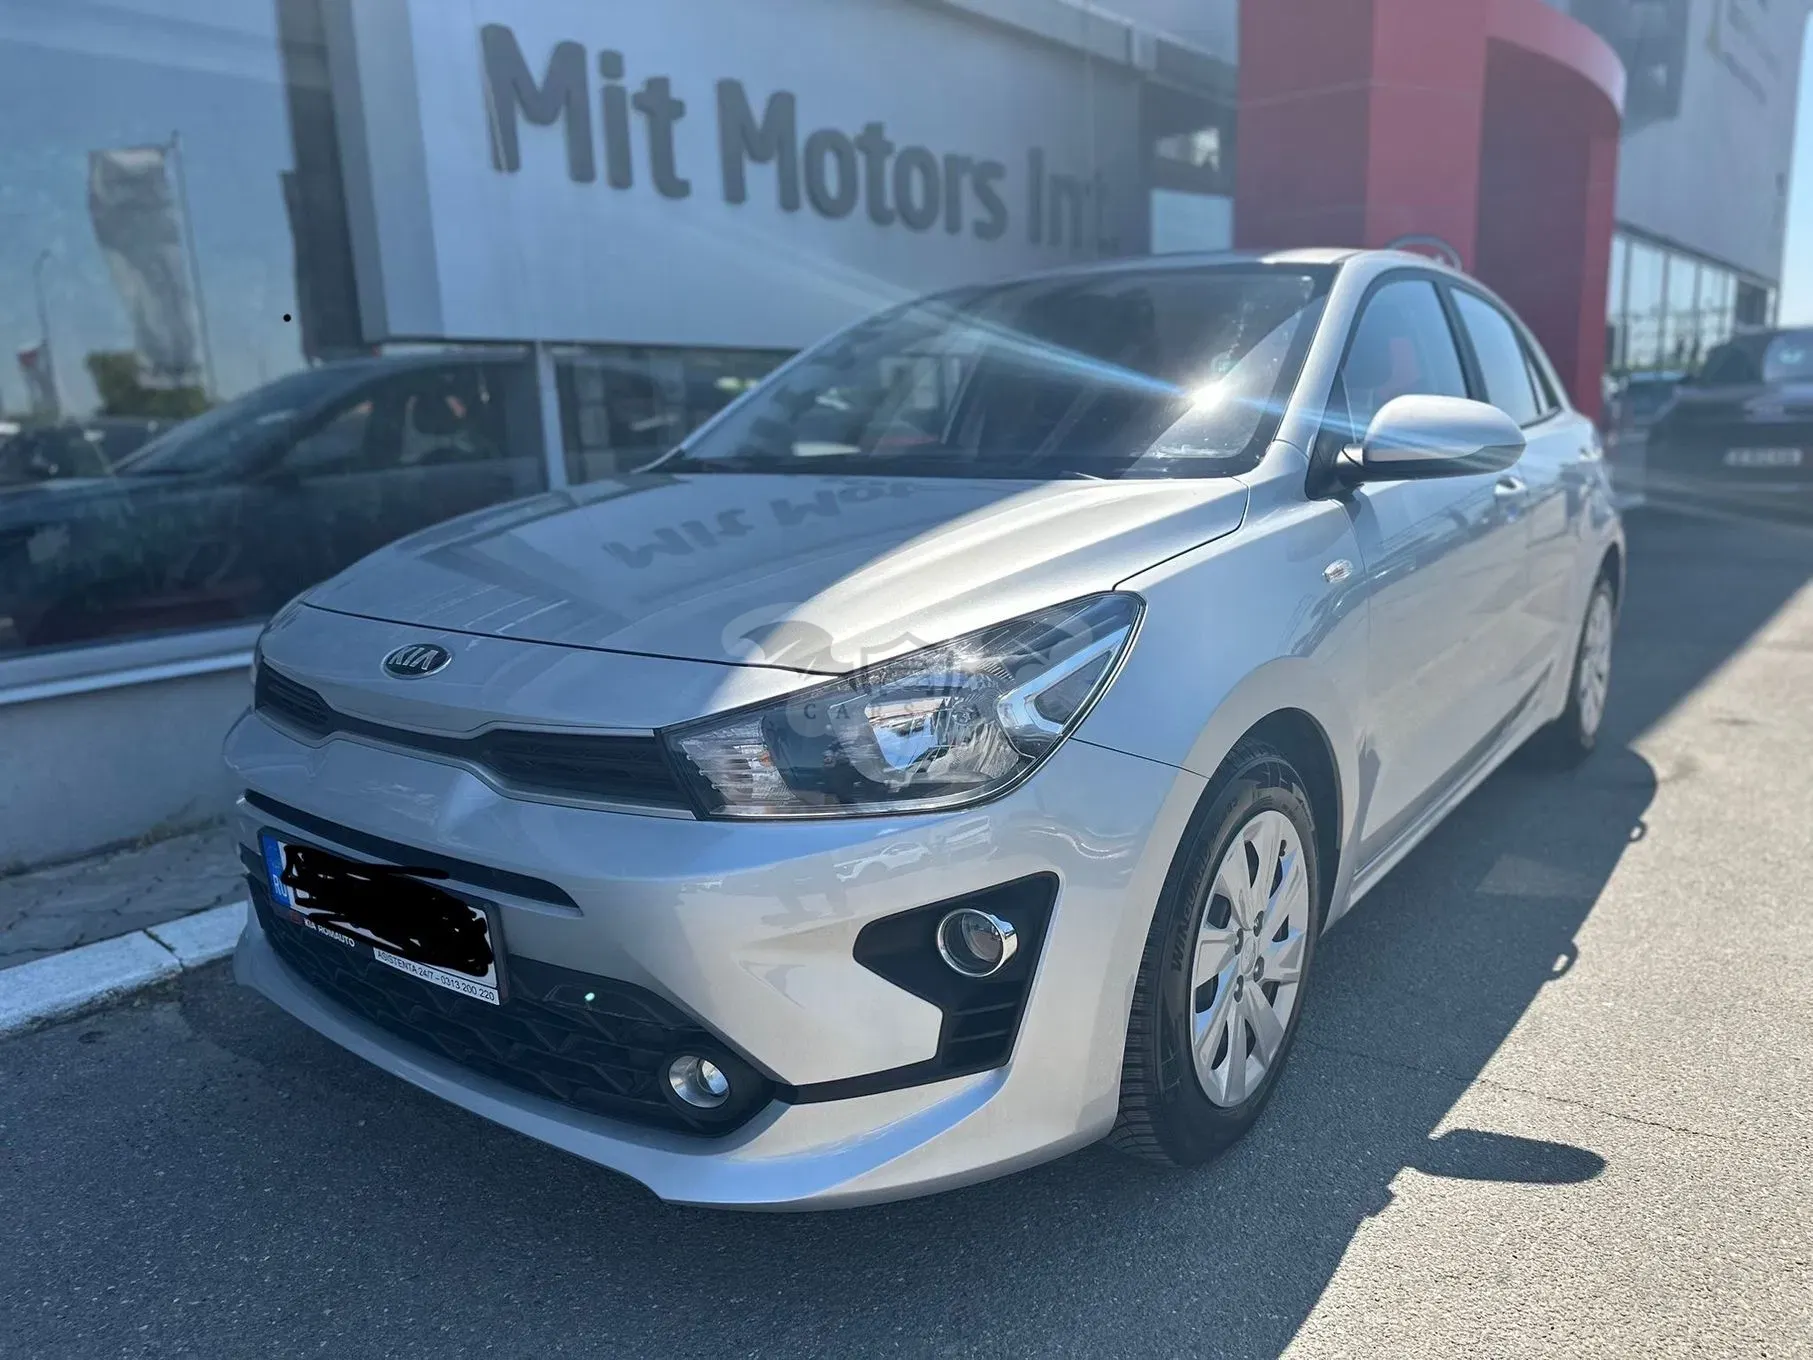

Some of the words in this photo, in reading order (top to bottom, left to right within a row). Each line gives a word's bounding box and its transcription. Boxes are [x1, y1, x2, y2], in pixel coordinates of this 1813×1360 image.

[481, 23, 690, 198] Mit
[715, 78, 1007, 241] Motors
[387, 645, 439, 671] KIA
[317, 924, 355, 948] ROMAUTO
[377, 950, 418, 975] ASISTENTA
